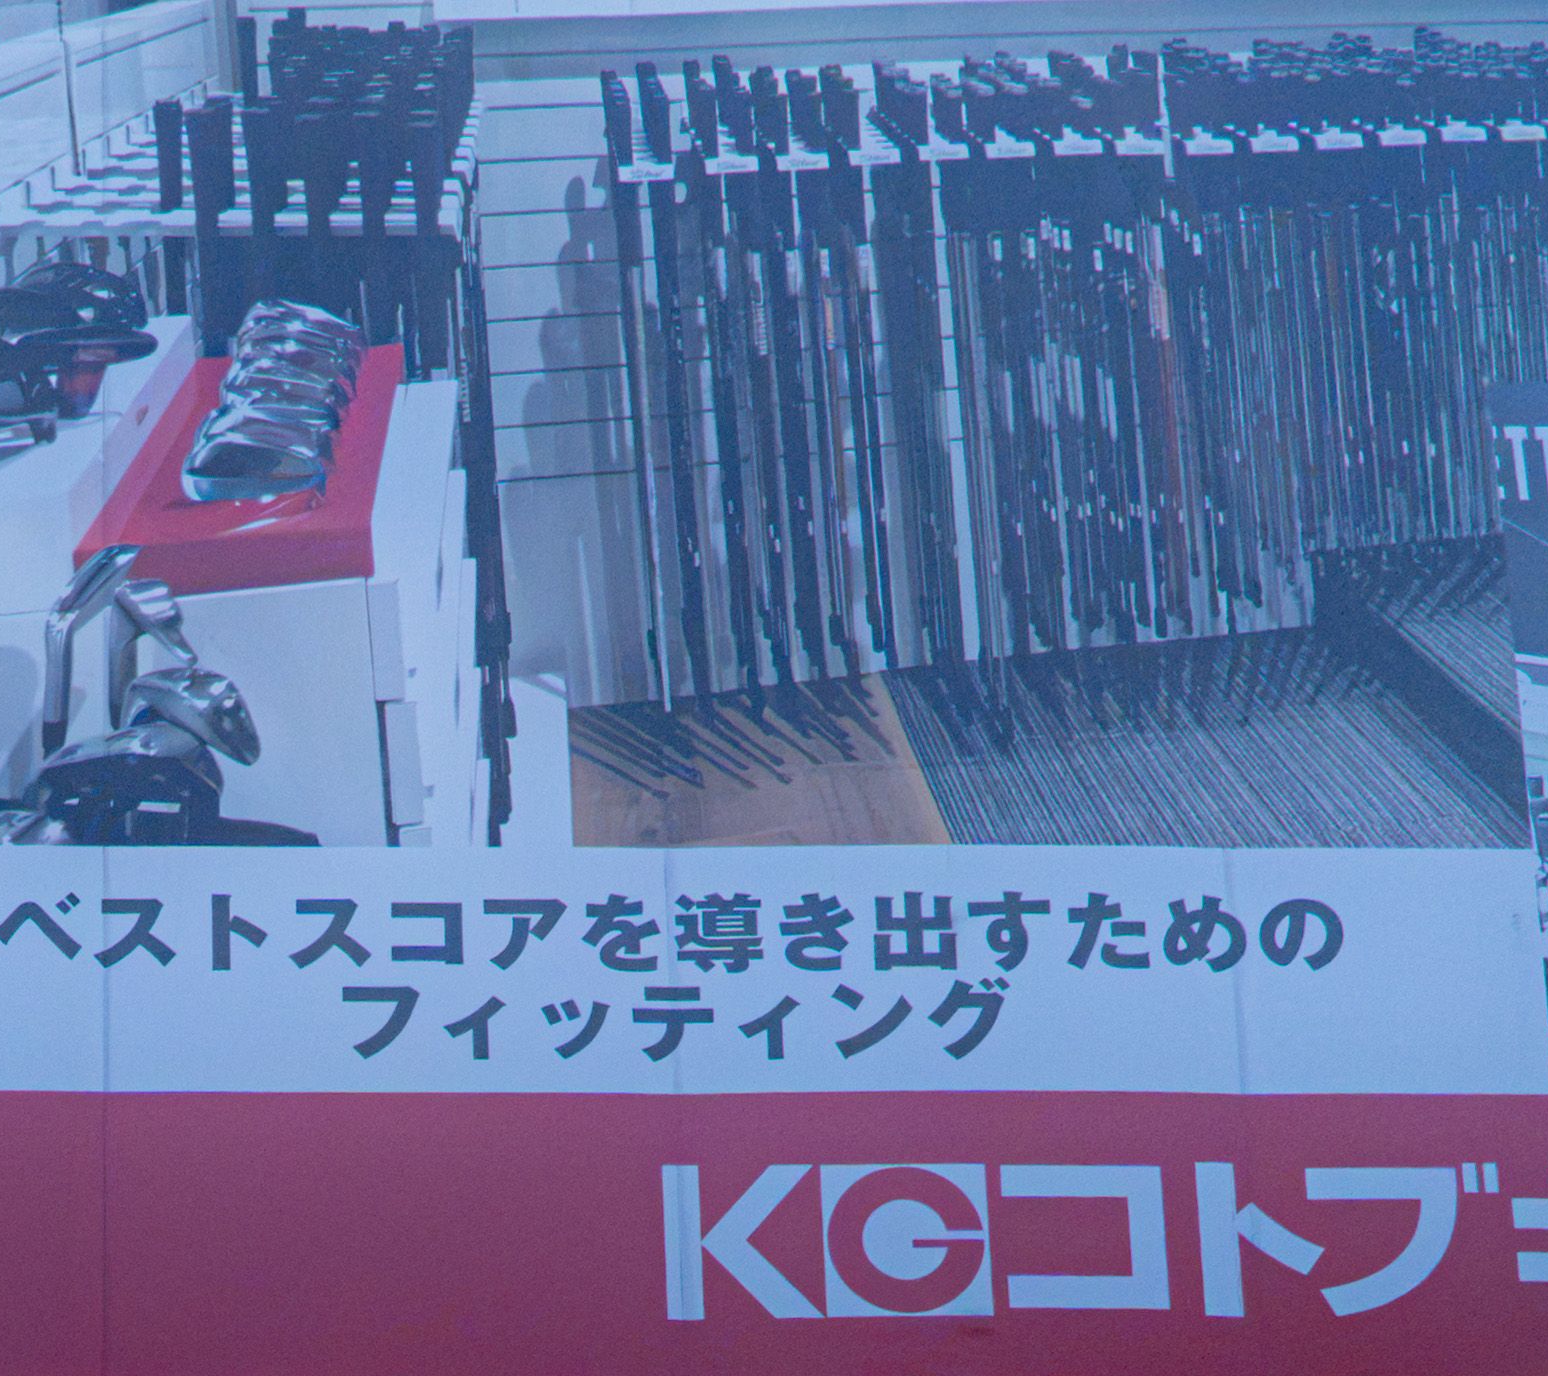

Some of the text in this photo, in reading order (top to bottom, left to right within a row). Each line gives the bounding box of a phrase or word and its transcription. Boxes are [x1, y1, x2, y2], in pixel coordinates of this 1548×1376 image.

[340, 981, 1010, 1063] フィッティング
